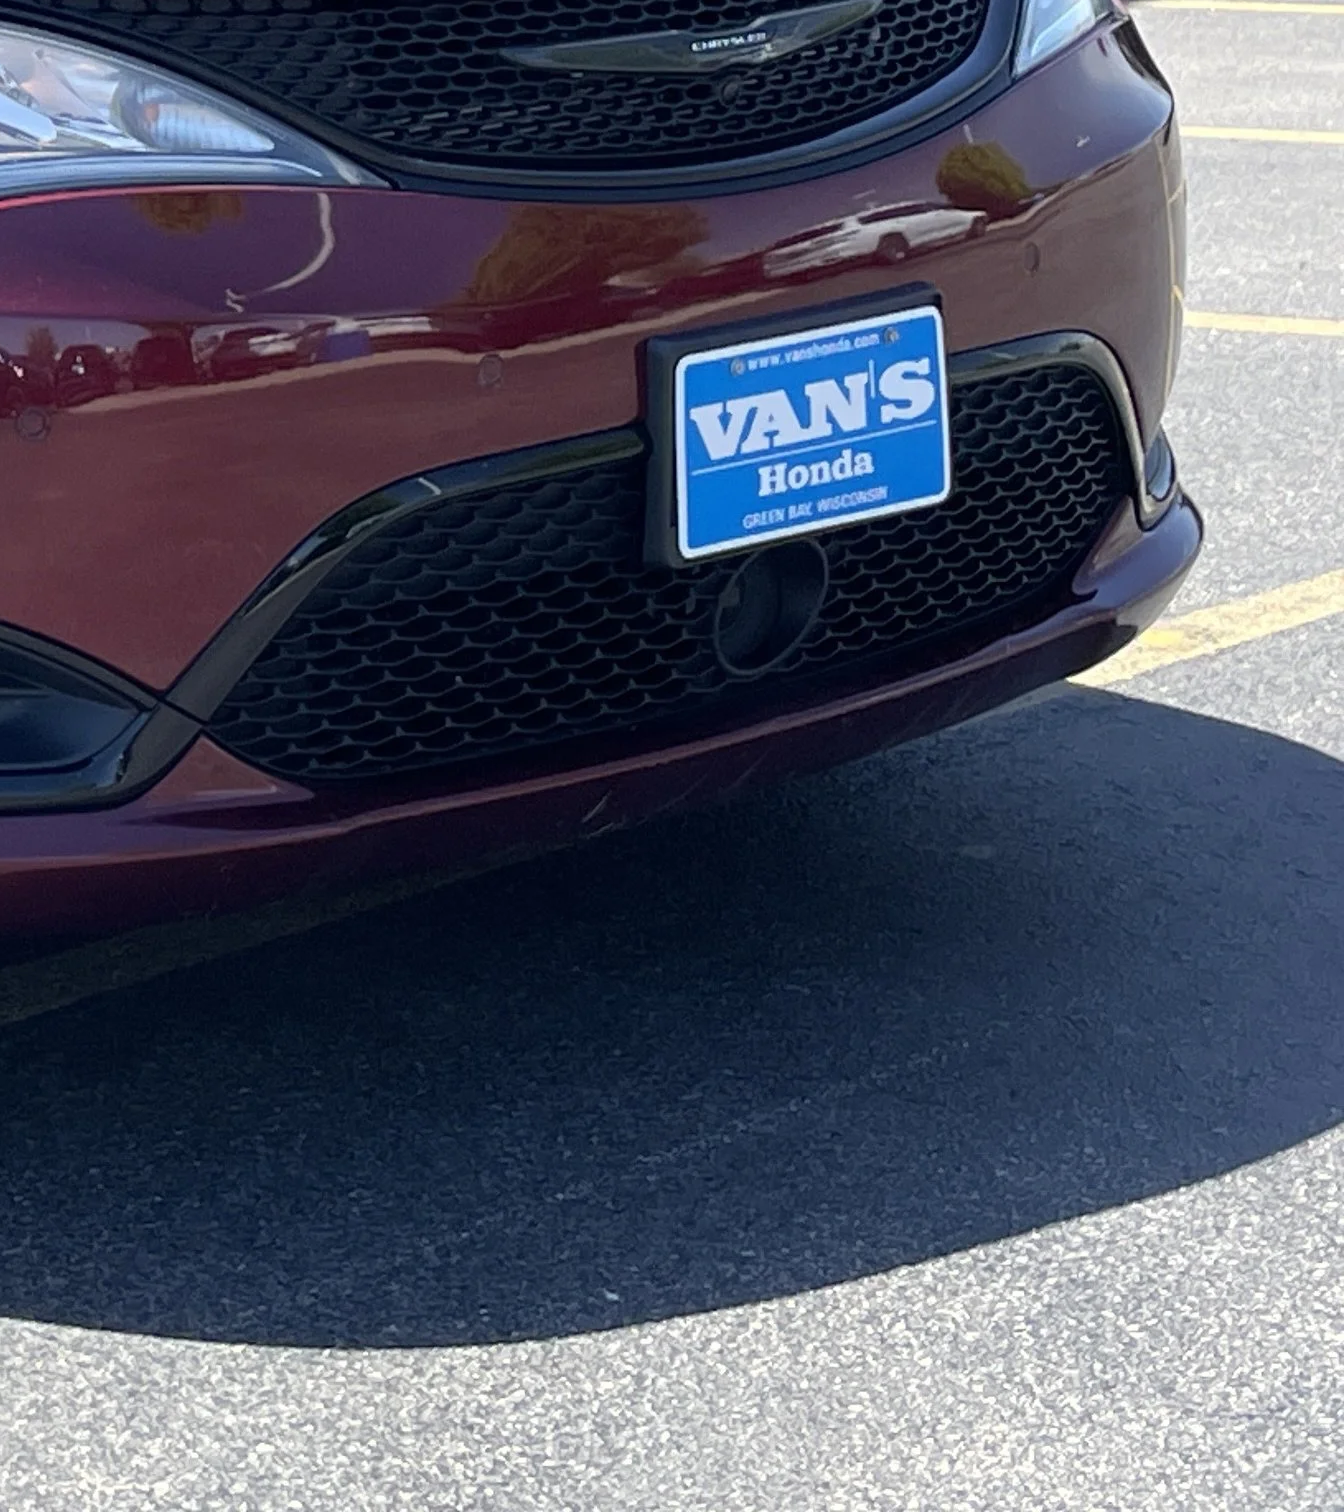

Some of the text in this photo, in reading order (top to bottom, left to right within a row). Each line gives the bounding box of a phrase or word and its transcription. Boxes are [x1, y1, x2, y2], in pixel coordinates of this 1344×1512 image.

[689, 357, 935, 461] VAN'S
[758, 448, 874, 497] Honda
[742, 486, 889, 529] GREEN BAY WISCONSIN
